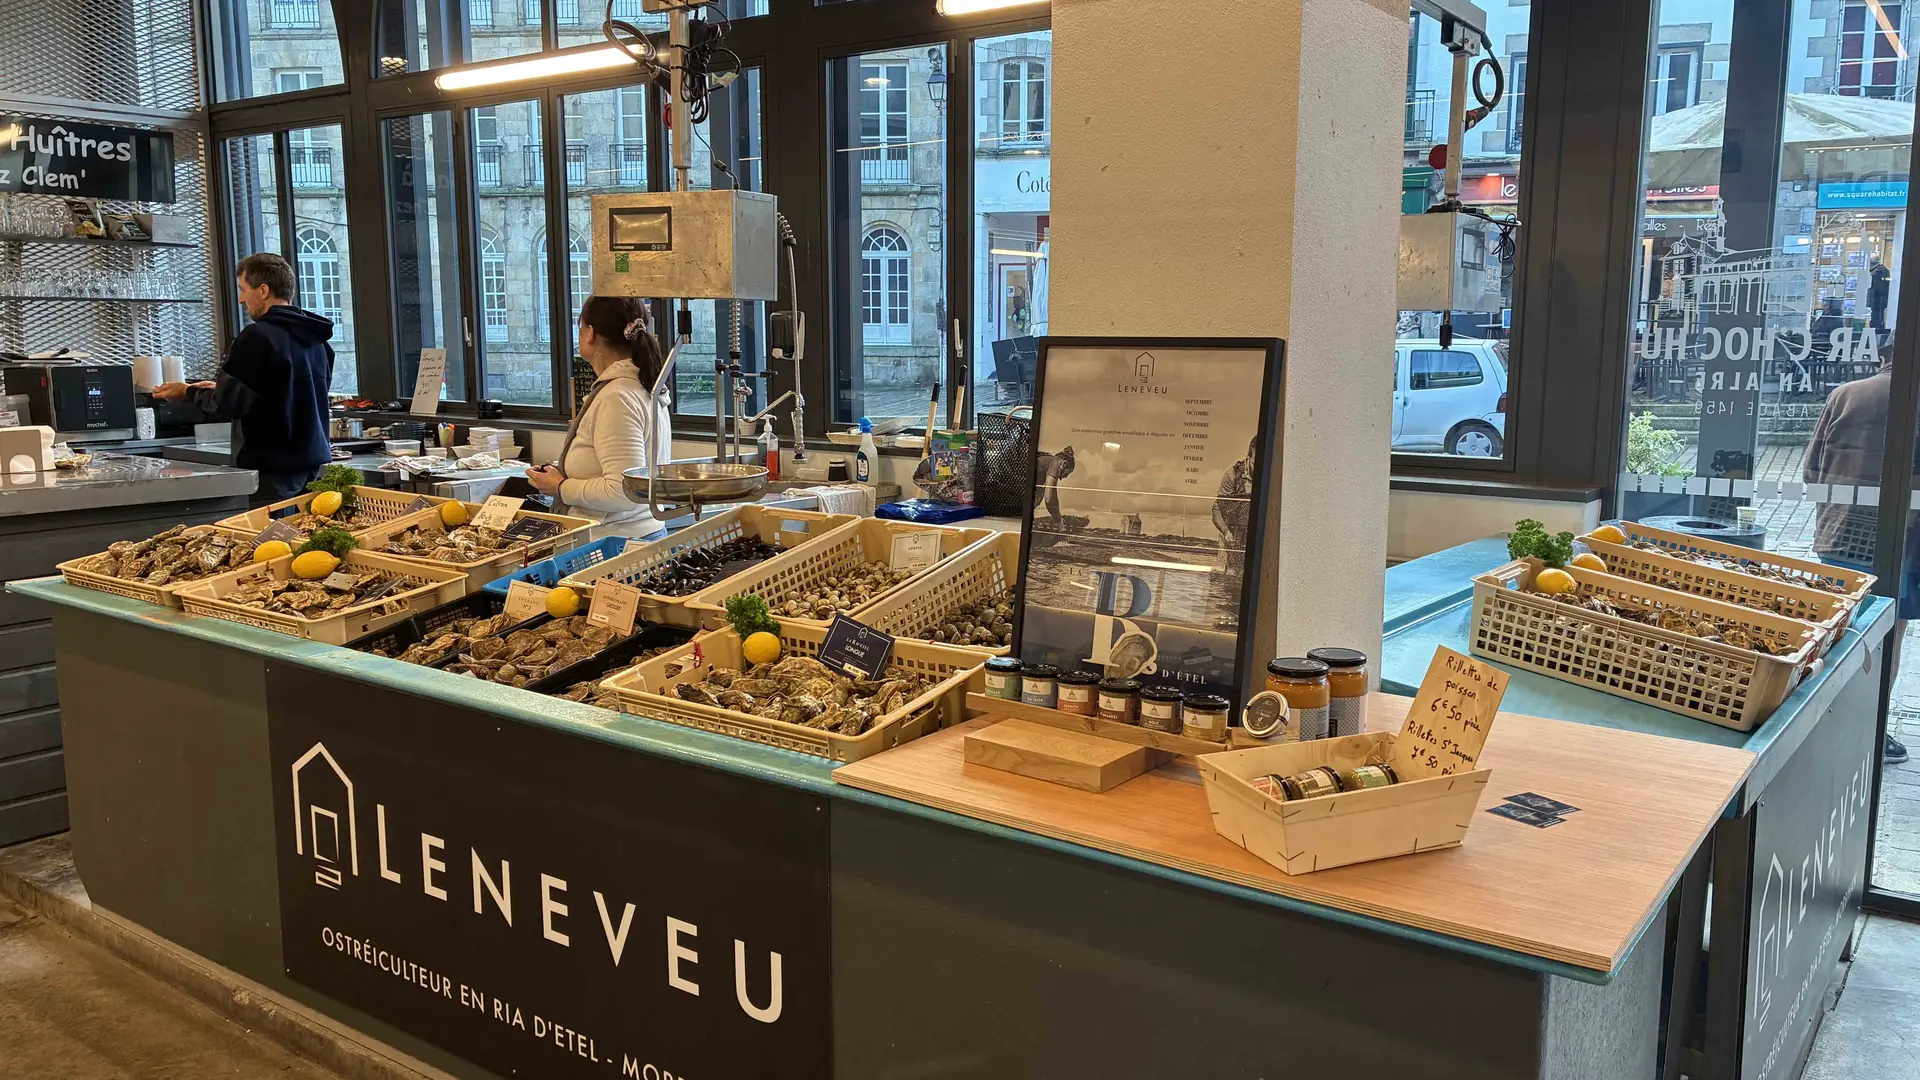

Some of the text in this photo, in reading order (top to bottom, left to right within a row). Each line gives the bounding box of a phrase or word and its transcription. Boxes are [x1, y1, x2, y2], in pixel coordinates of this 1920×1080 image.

[10, 123, 132, 162] Huîtres
[22, 166, 86, 190] Clem'
[1501, 177, 1516, 197] le
[1827, 190, 1906, 199] www.squarehabitat.fr
[1118, 384, 1168, 394] LENEVEU
[1162, 669, 1207, 684] D'ÉTEL
[1487, 676, 1498, 692] de
[1786, 752, 1870, 949] LENEVEU
[376, 804, 783, 1024] LENEVEU
[322, 926, 452, 999] OSTRÉICULTEUR
[460, 984, 485, 1014] EN
[494, 998, 526, 1031] RIA
[534, 1015, 598, 1062] D'ETEL
